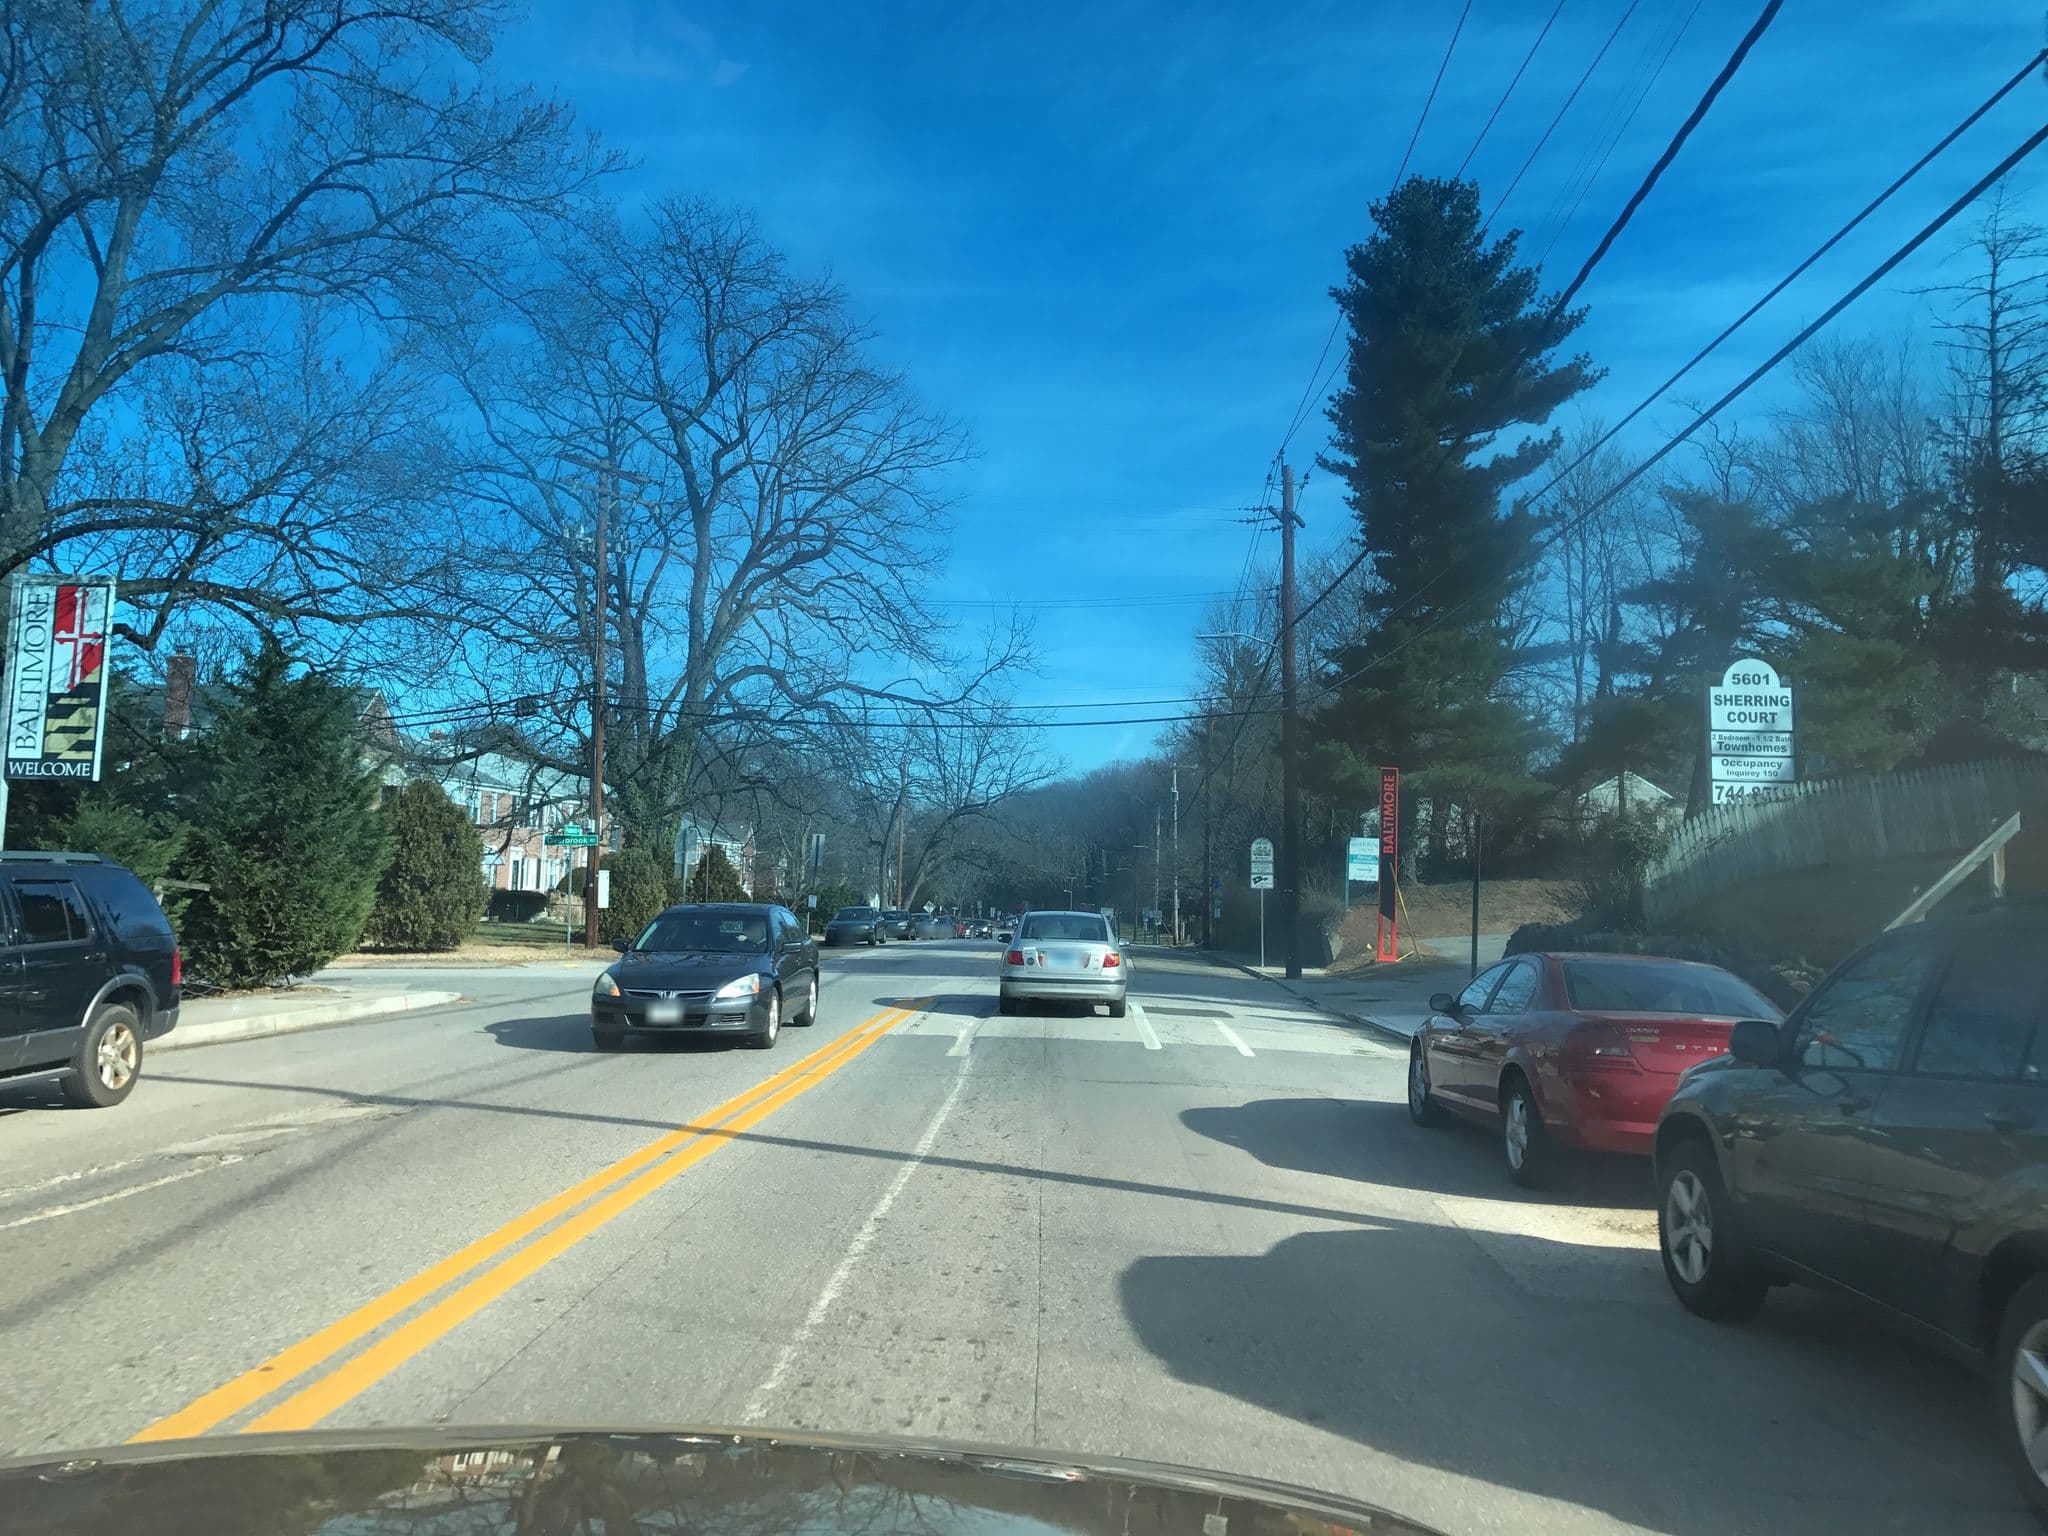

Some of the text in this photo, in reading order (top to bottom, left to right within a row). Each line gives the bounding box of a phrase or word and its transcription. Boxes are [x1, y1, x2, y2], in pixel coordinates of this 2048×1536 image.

[15, 592, 49, 750] BALTIMORE
[1732, 673, 1770, 686] 5601
[1713, 694, 1790, 707] SHERRING
[1727, 711, 1778, 724] COURT
[1775, 735, 1793, 743] Bath
[1717, 741, 1787, 753] Townhomes
[9, 761, 91, 777] WELCOME
[1721, 758, 1783, 770] Occupancy
[1727, 769, 1760, 778] Inquirey
[1383, 775, 1395, 854] BALTIMORE
